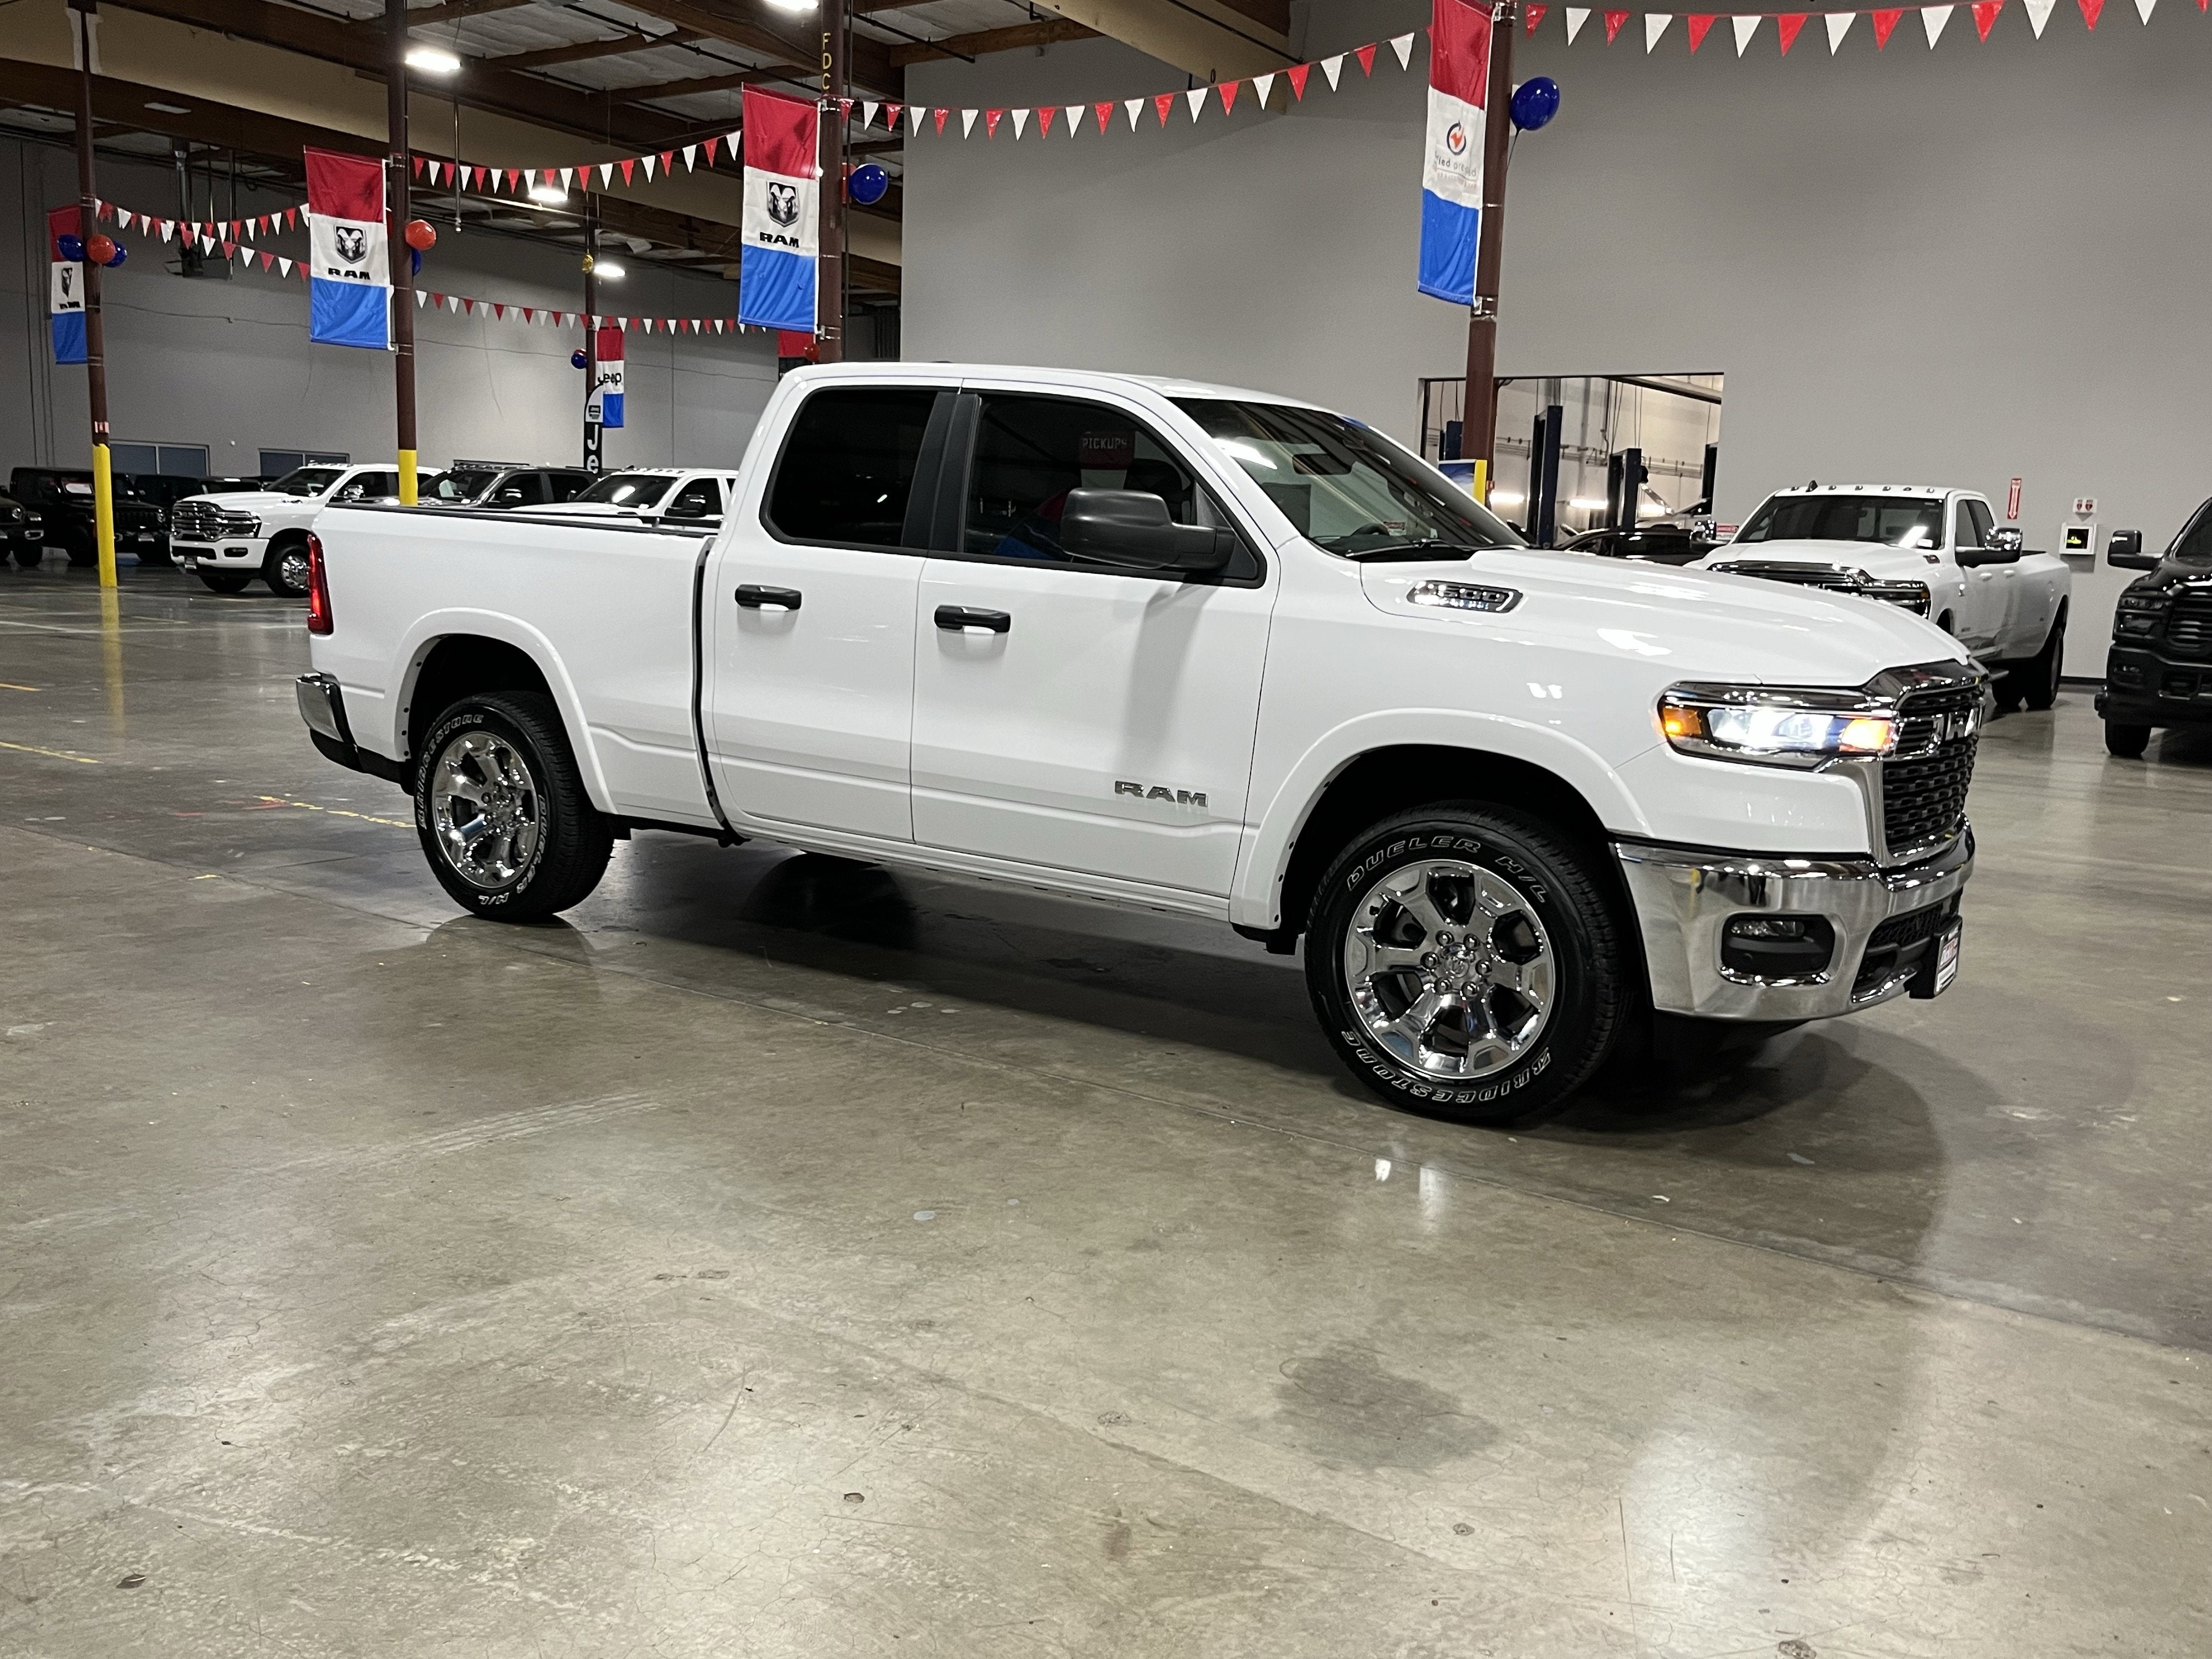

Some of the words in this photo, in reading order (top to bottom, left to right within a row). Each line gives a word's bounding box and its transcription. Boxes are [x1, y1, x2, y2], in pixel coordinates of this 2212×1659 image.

[822, 32, 832, 90] FDC
[759, 232, 799, 248] RAM
[328, 267, 371, 280] RAM
[597, 373, 622, 386] Jeep
[587, 424, 599, 474] Je
[1115, 780, 1209, 808] RAM
[1346, 835, 1481, 892] DUELER
[1341, 1030, 1551, 1104] BRIDGESTONE
